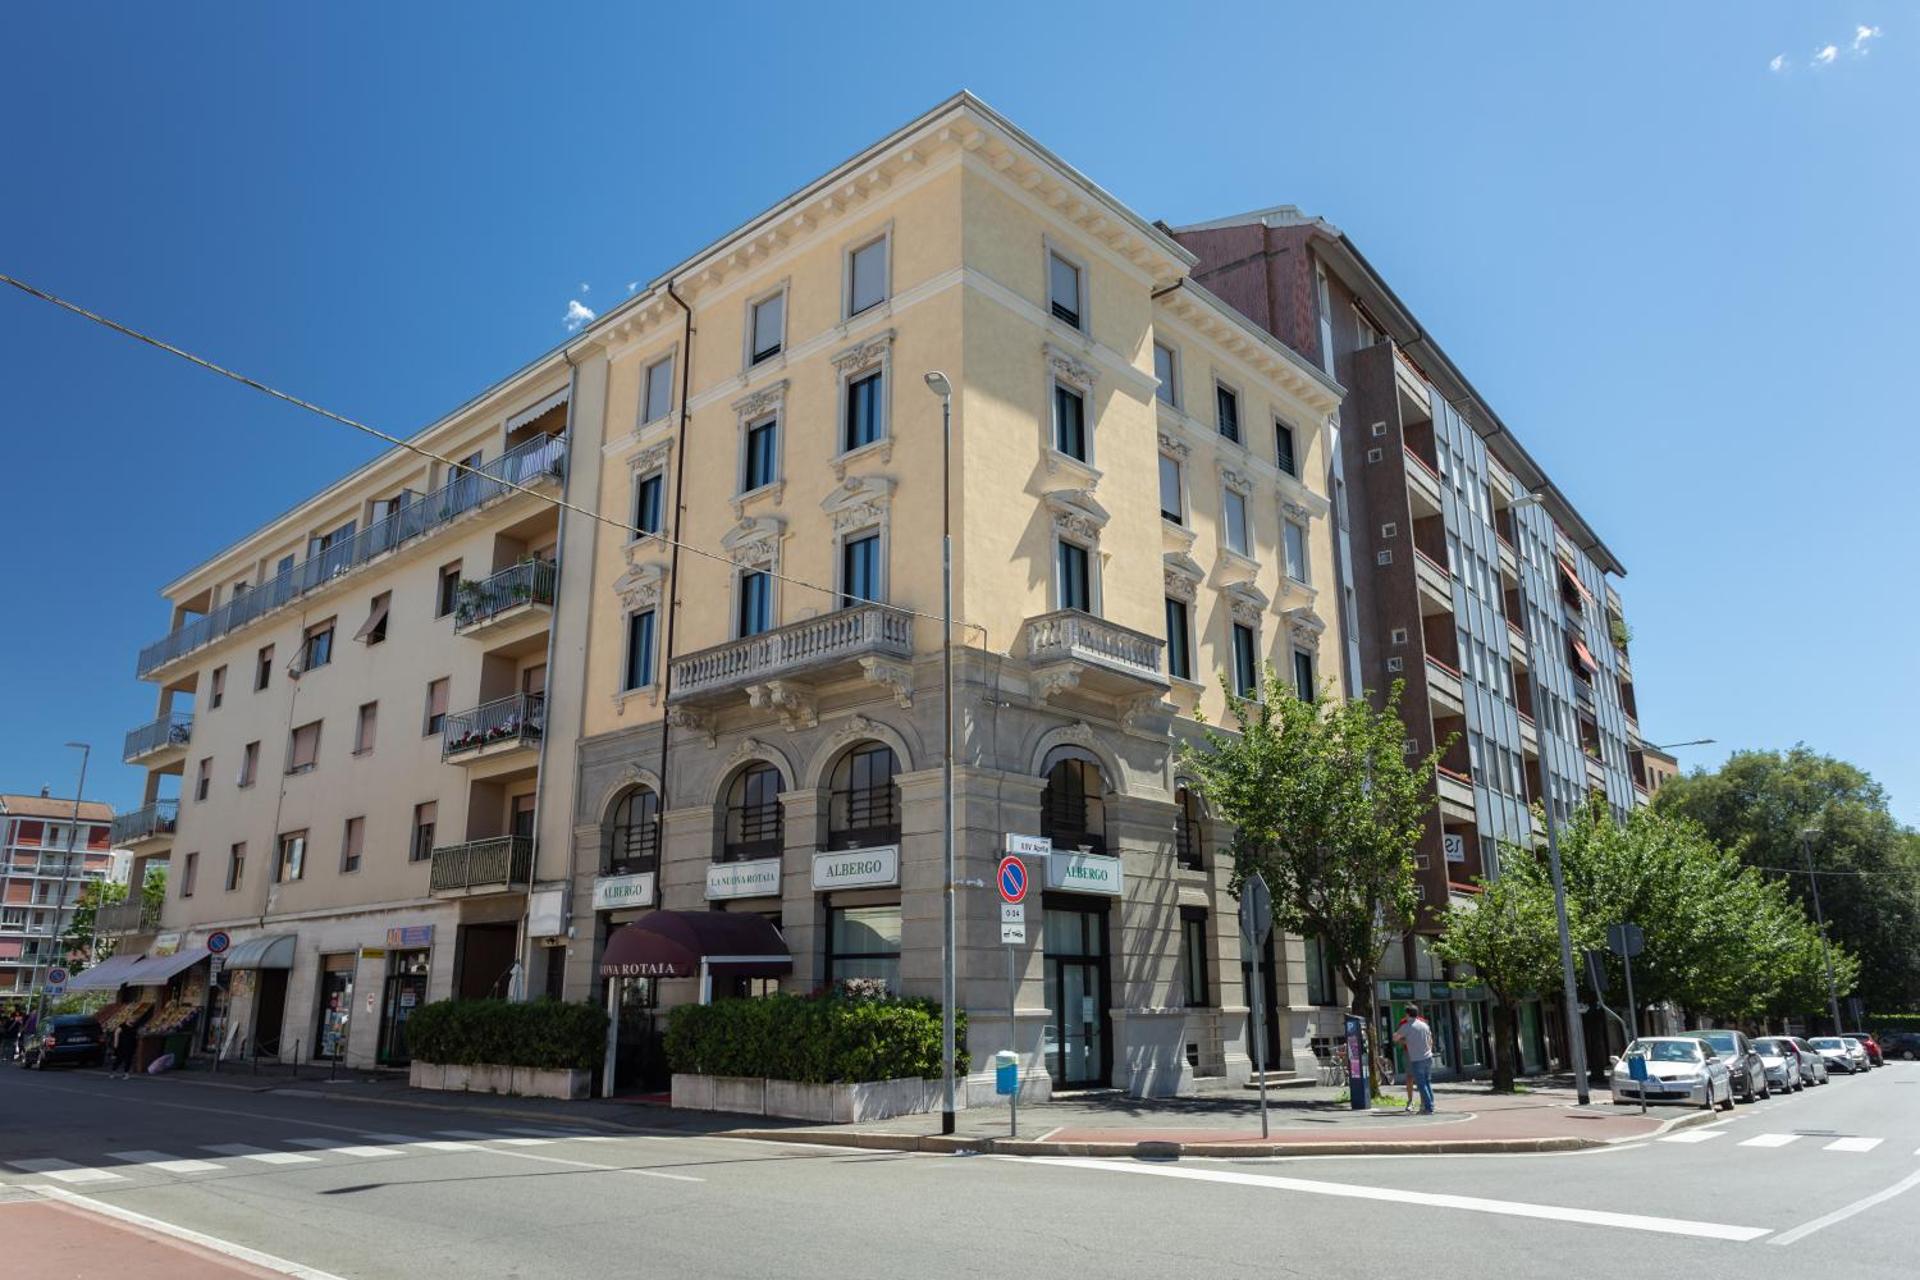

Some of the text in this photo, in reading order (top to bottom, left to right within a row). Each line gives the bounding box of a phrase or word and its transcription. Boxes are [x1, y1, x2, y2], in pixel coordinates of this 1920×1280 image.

[825, 859, 882, 878] ALBERGO
[1065, 865, 1108, 881] ALBERGO
[721, 874, 746, 886] NUOVA
[747, 871, 776, 884] ROTAIA
[604, 884, 642, 898] ALBERGO
[622, 962, 675, 975] ROTAIA
